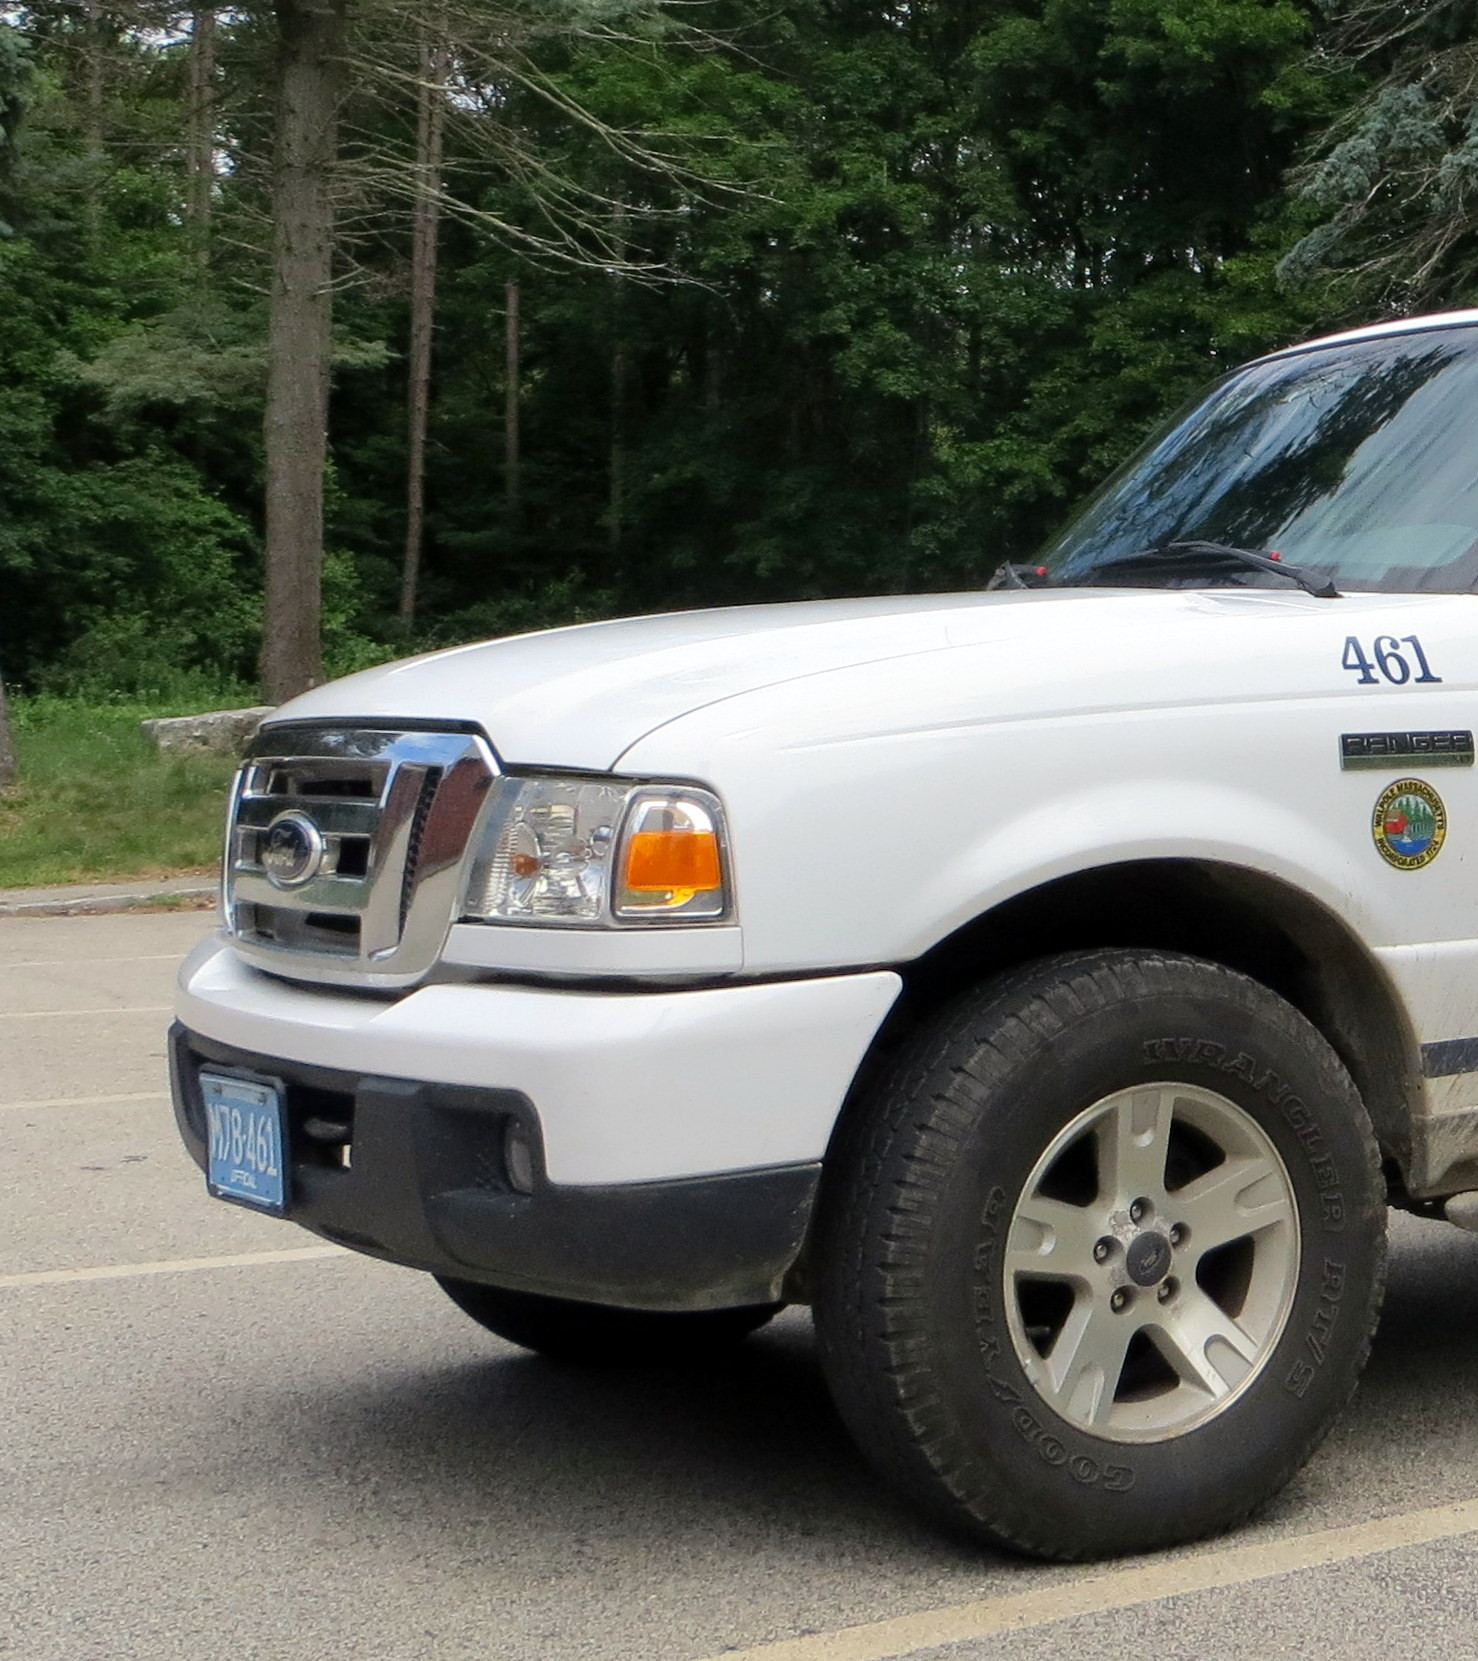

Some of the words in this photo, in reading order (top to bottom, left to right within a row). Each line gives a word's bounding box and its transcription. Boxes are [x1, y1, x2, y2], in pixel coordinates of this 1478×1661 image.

[1342, 635, 1443, 684] 461
[1374, 787, 1396, 828] WALPOLE
[1143, 1035, 1348, 1234] WRANGLER
